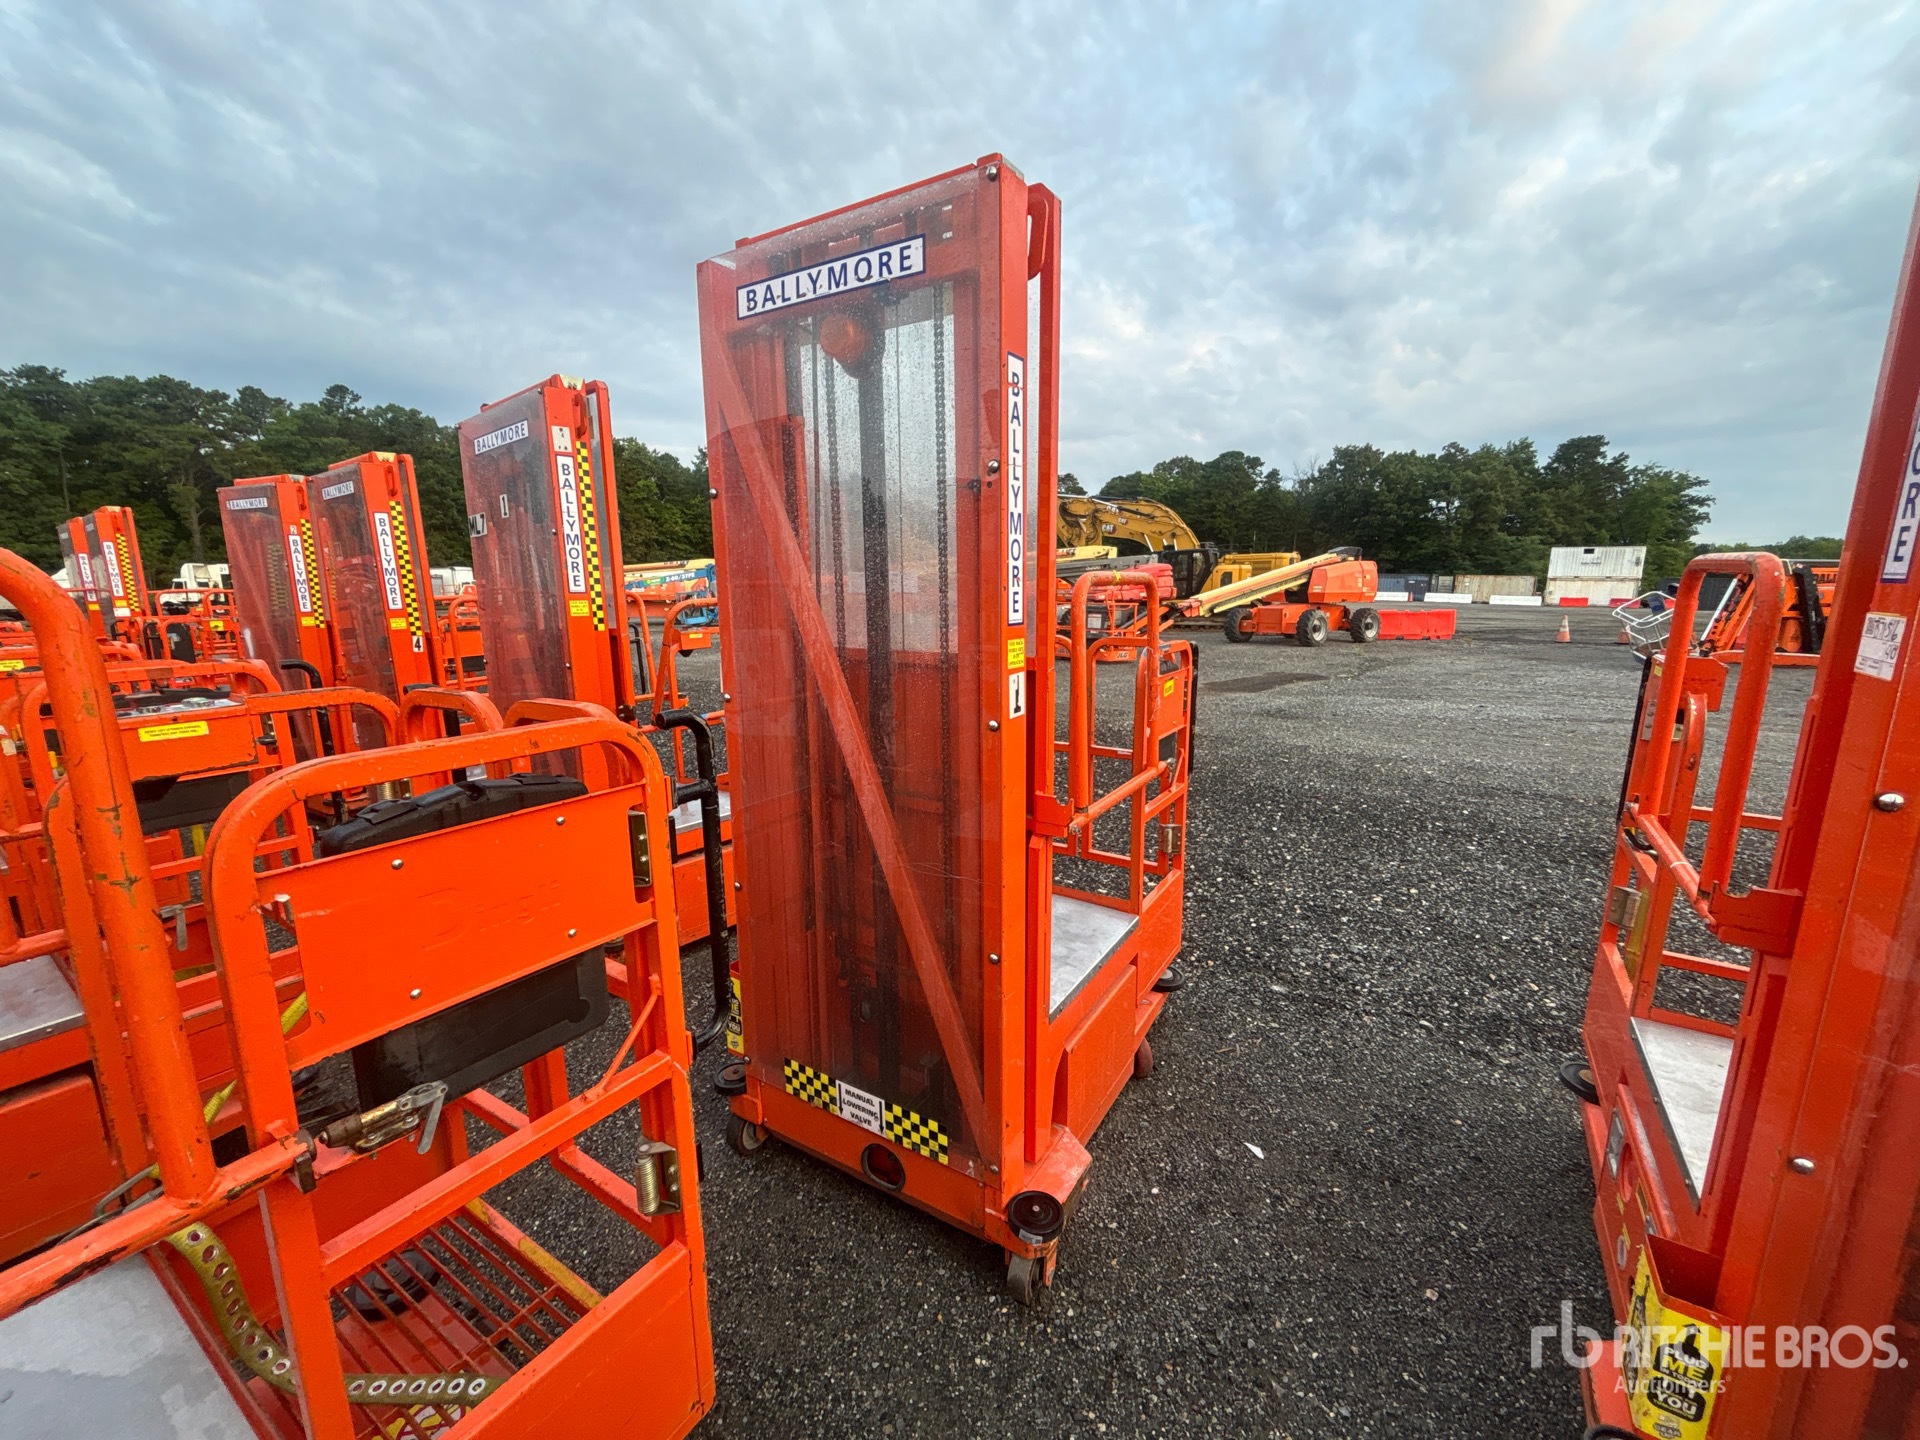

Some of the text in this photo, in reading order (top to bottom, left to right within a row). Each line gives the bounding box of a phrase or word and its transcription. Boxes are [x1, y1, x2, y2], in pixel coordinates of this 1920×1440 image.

[746, 244, 913, 313] BALLYMORE
[475, 422, 526, 452] BALLYMORE
[323, 482, 353, 498] BALLYMORE
[1009, 371, 1022, 613] BALLYMORE
[562, 463, 581, 587] BALLYMORE
[1101, 524, 1114, 533] CAT
[106, 544, 121, 595] BALLYMORE
[291, 539, 309, 610] BALLYMORE
[379, 518, 399, 606] BALLYMORE
[414, 636, 422, 650] 4
[842, 1097, 880, 1120] LOWERING
[845, 1088, 876, 1108] MANUAL
[849, 1111, 873, 1127] VALVE
[1661, 1355, 1706, 1381] ME
[1663, 1346, 1709, 1370] PLUG
[1656, 1390, 1697, 1415] YOU
